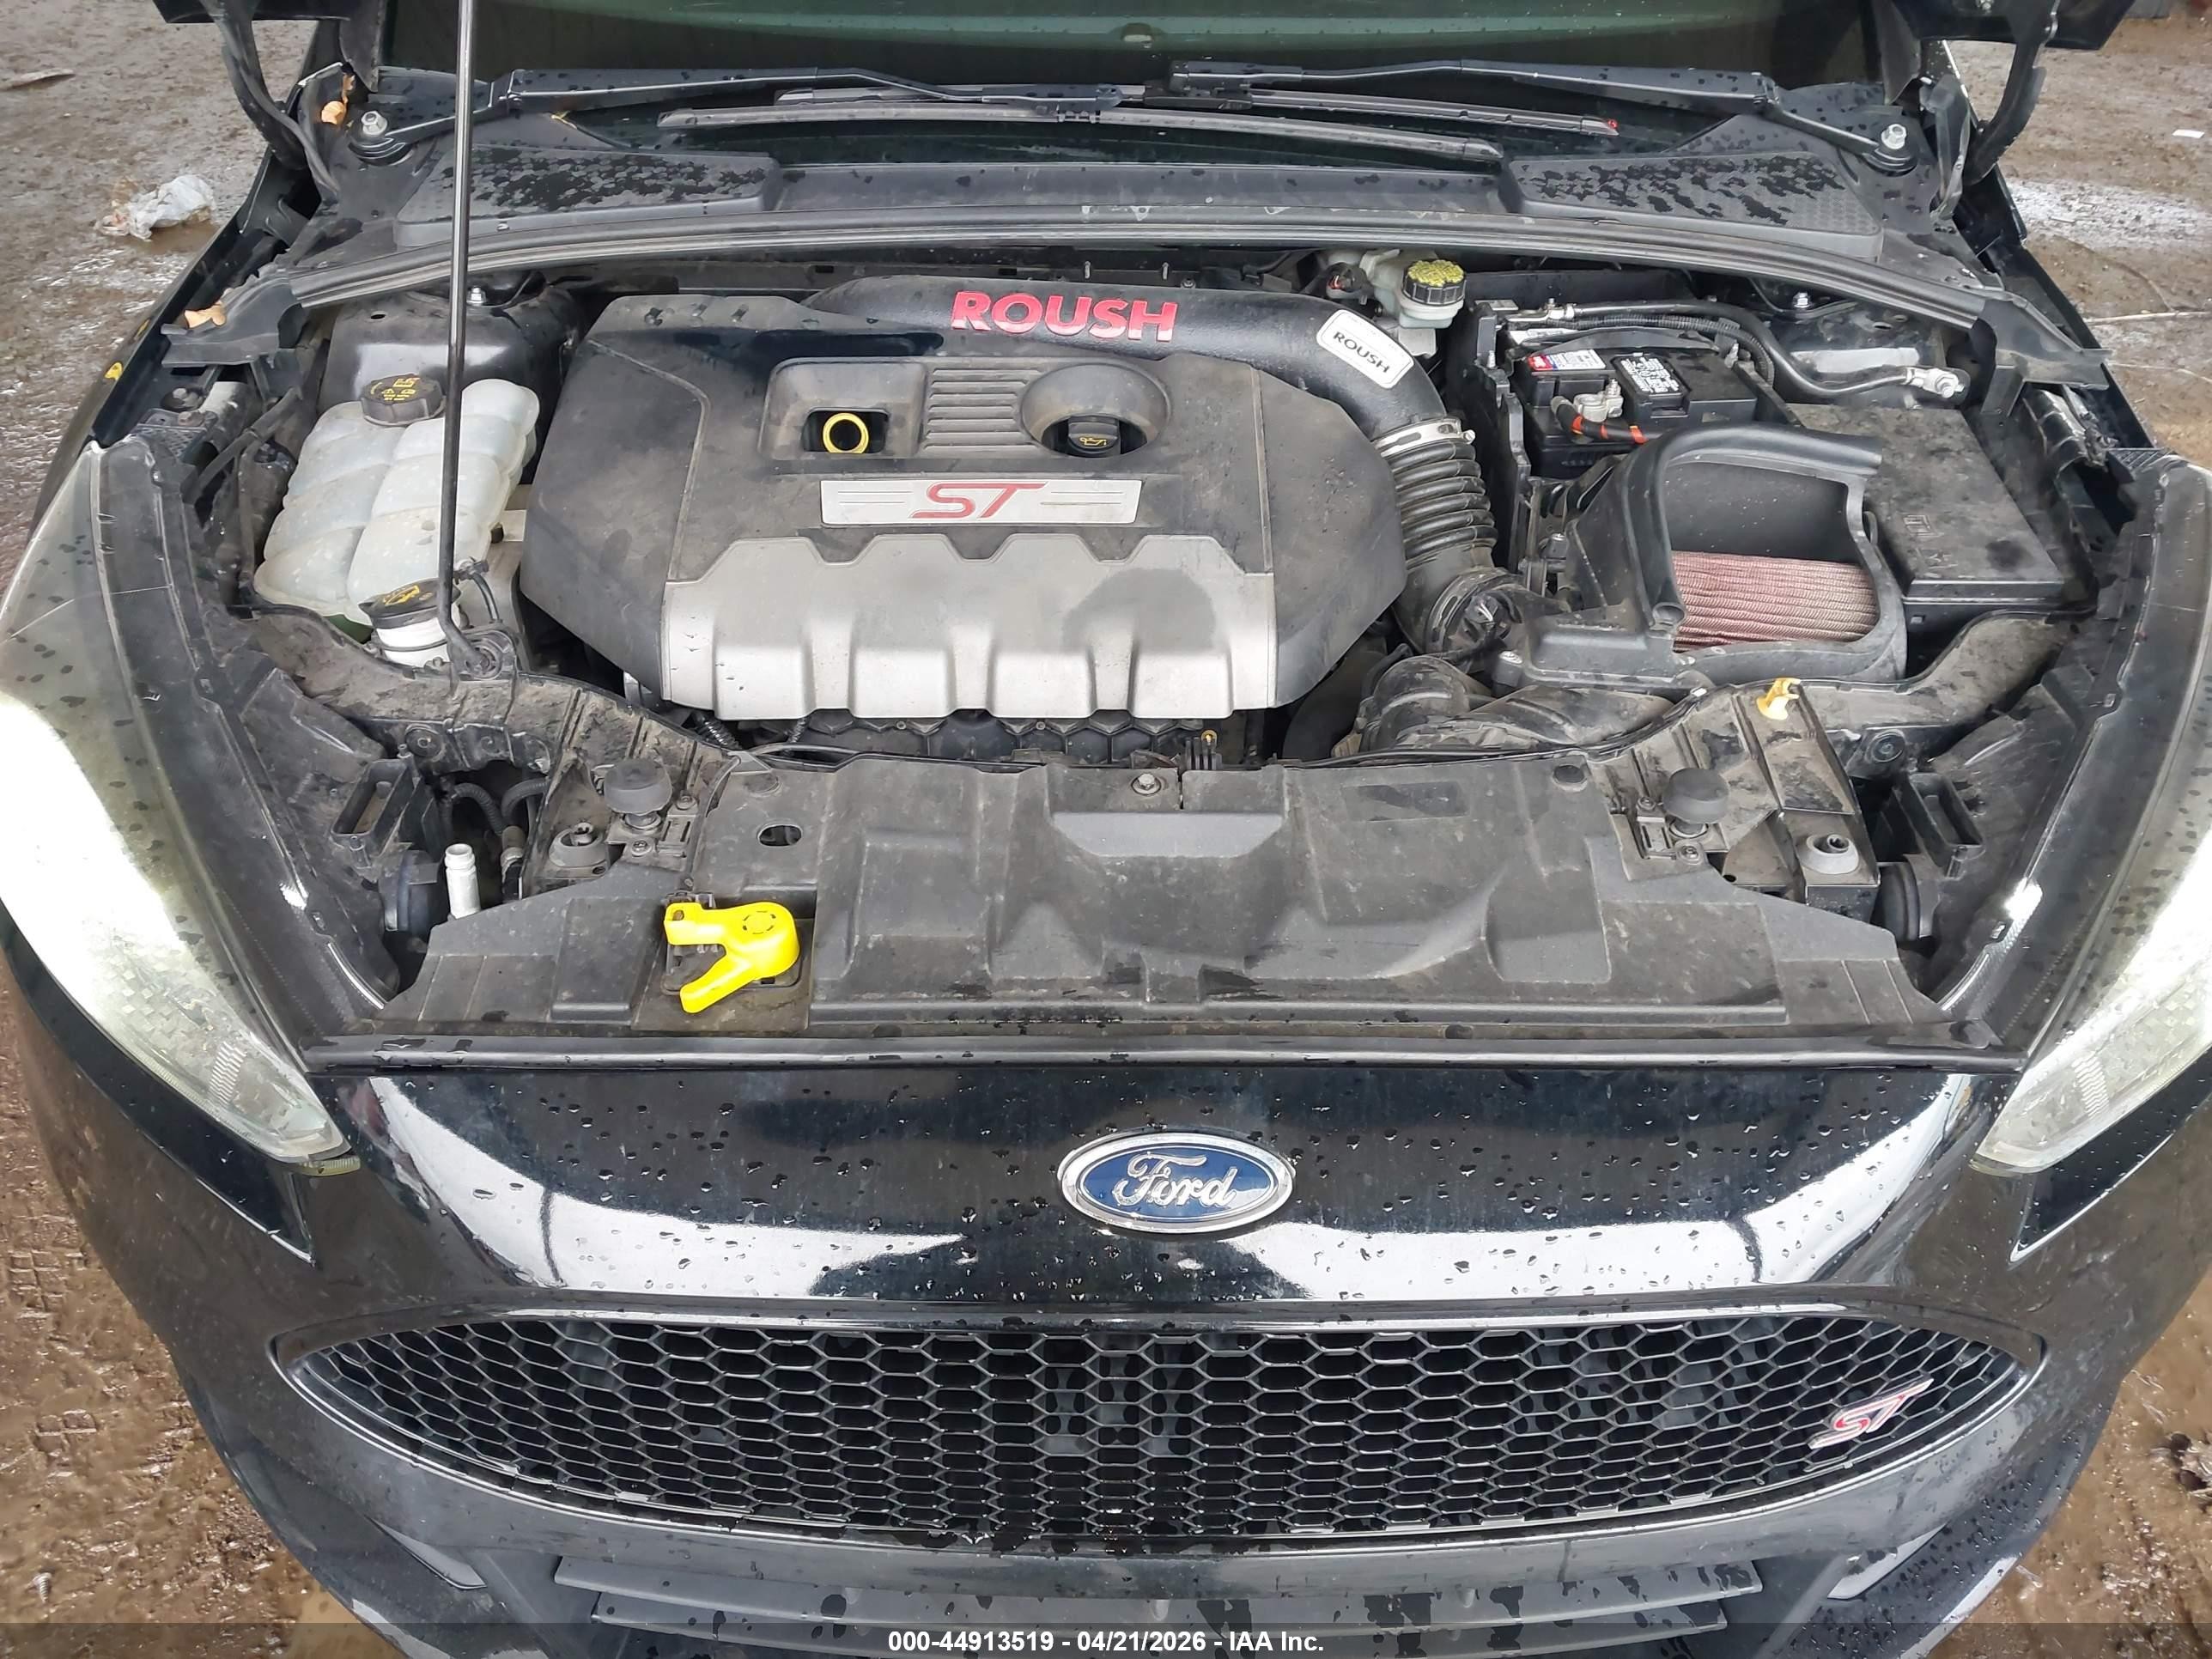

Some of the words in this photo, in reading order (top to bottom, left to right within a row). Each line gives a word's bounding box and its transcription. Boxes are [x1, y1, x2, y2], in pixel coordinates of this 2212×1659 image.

[951, 290, 1178, 343] ROUSH
[1333, 331, 1390, 374] ROUSH
[908, 482, 1048, 519] ST
[1112, 1152, 1238, 1207] Ford
[1807, 1377, 1935, 1450] ST
